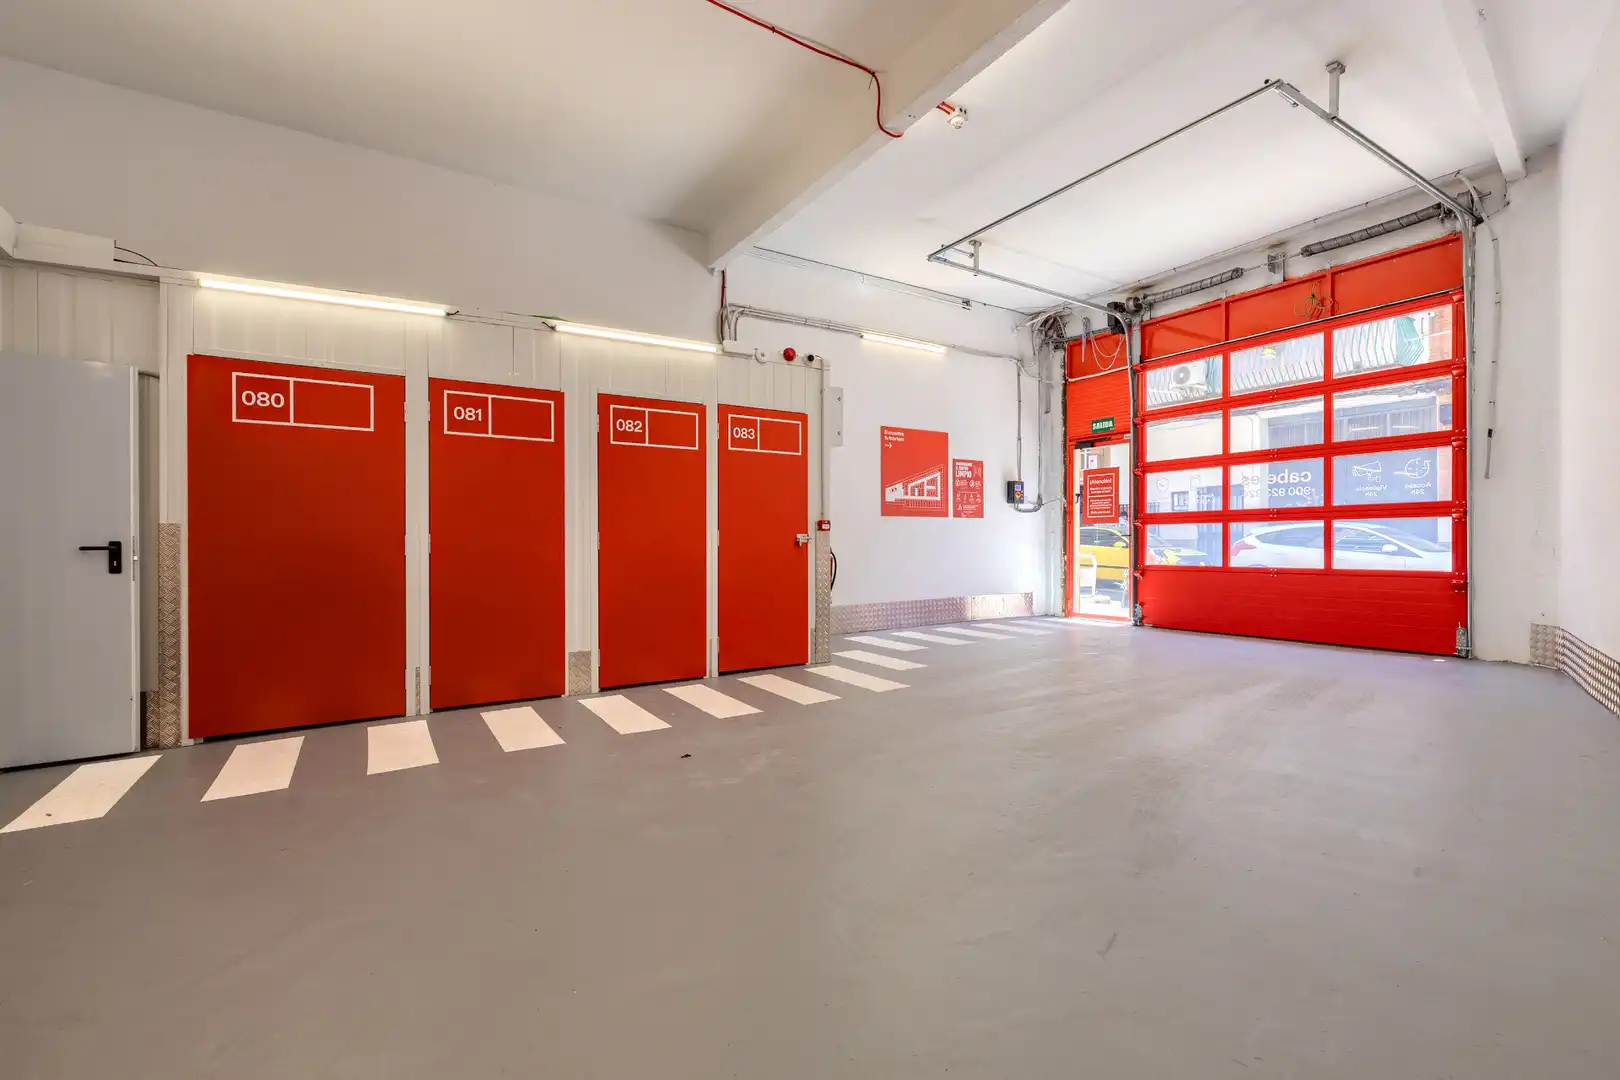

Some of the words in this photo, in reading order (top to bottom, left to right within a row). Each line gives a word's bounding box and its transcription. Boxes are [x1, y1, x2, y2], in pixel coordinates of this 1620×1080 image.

[241, 390, 285, 409] 080
[453, 406, 483, 422] 081
[615, 419, 643, 433] 082
[1092, 421, 1113, 430] SALIDA
[732, 427, 756, 440] 083
